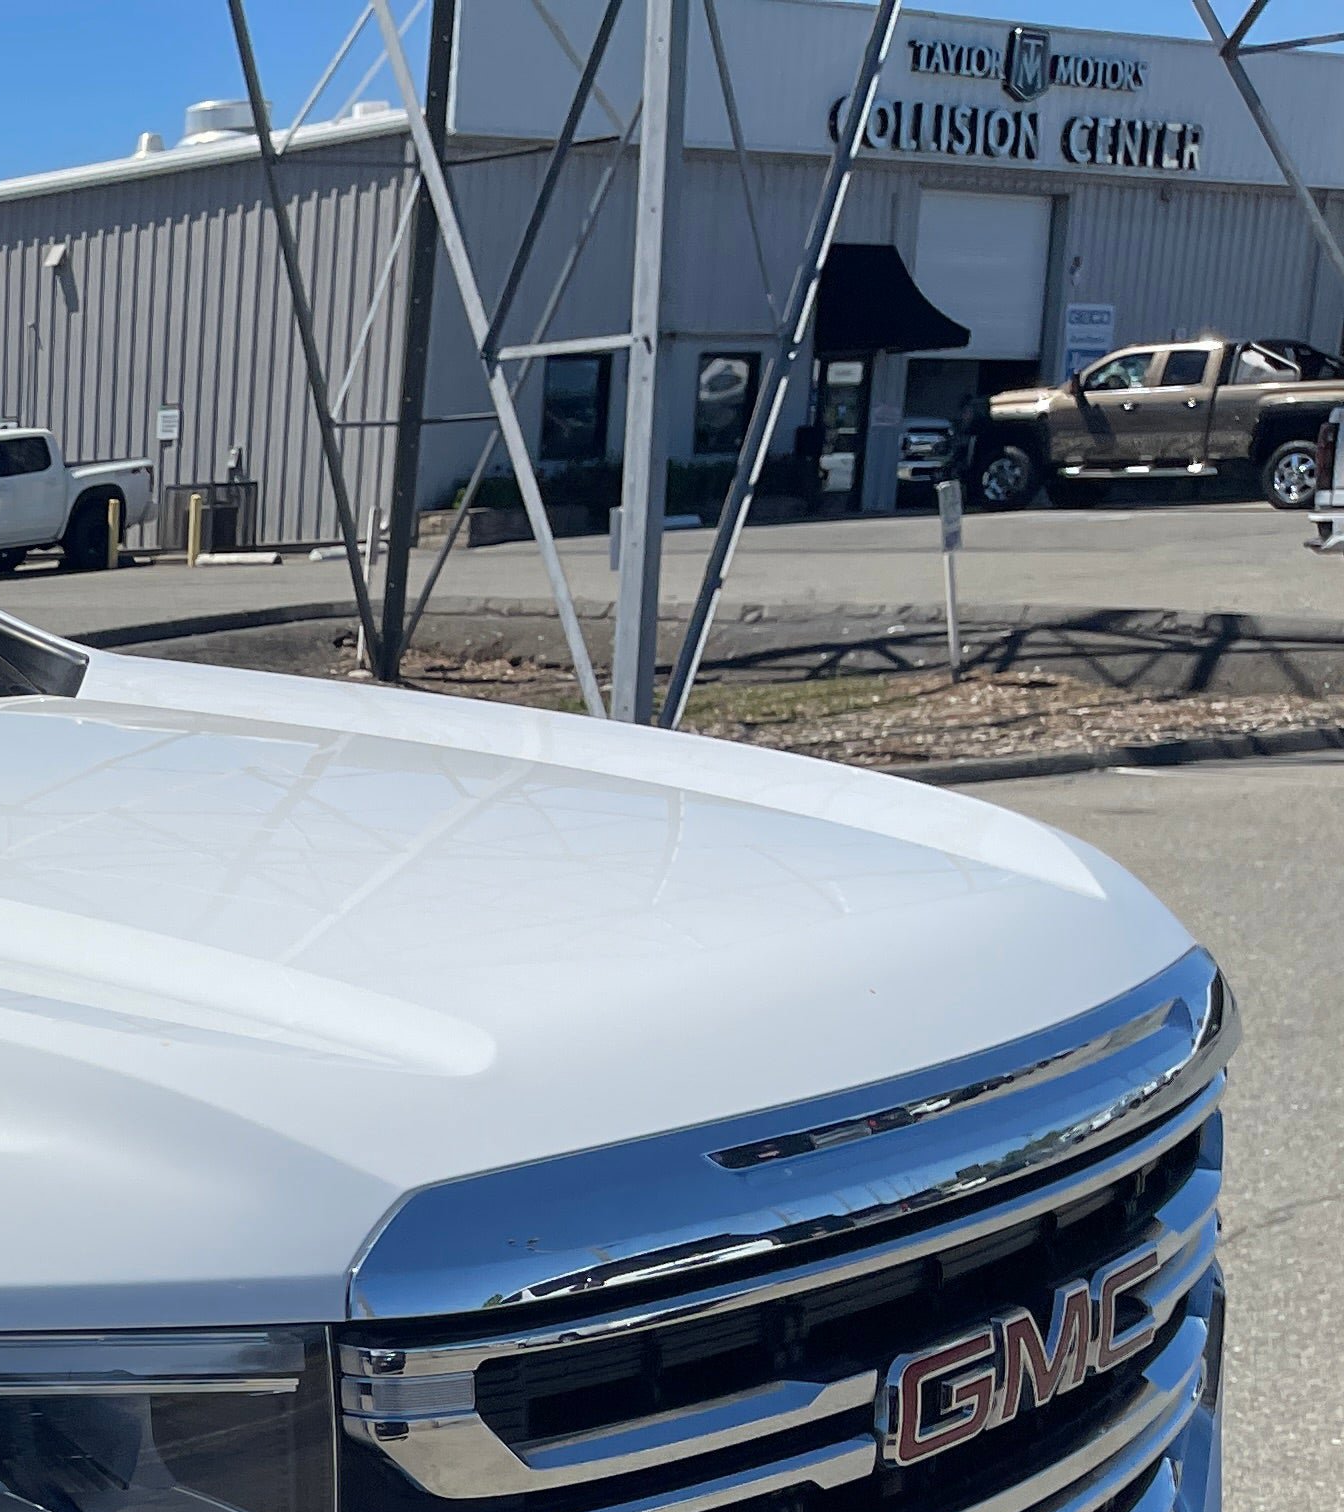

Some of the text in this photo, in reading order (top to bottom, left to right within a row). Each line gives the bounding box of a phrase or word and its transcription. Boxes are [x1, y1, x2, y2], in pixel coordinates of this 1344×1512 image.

[909, 40, 1006, 80] TAYLOR
[1051, 54, 1148, 90] MOTORS
[829, 95, 1204, 171] COLLISION CENTER
[880, 1238, 1161, 1467] GMC
